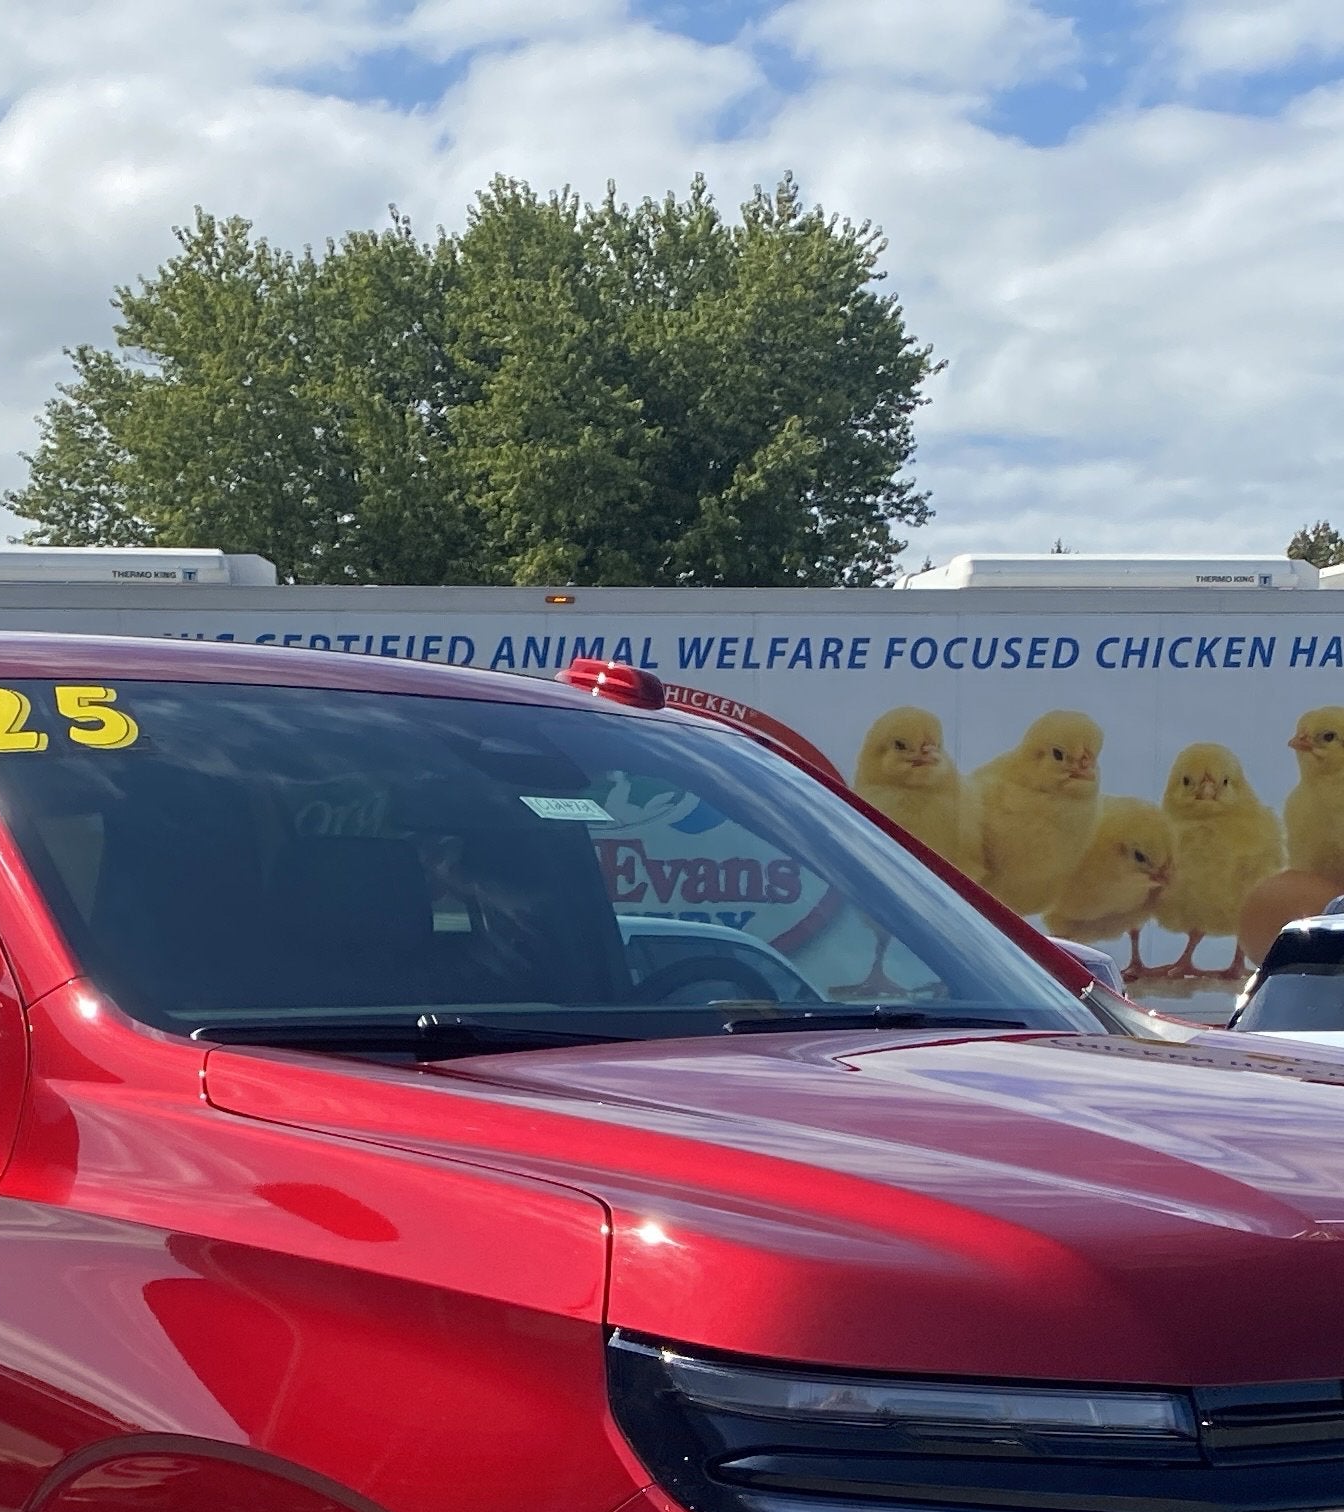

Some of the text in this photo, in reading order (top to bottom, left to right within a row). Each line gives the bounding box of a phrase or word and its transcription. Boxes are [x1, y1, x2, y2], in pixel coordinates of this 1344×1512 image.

[112, 570, 153, 579] THERMO
[154, 571, 177, 579] KING
[1195, 575, 1233, 583] THERMO
[1234, 575, 1255, 583] KING
[256, 633, 476, 667] TIFIED
[489, 635, 660, 670] ANIMAL
[677, 636, 871, 670] WELFARE
[883, 636, 1080, 670] FOCUSED
[1095, 636, 1276, 669] CHICKEN
[665, 685, 748, 720] HICKEN
[593, 837, 803, 905] Evans
